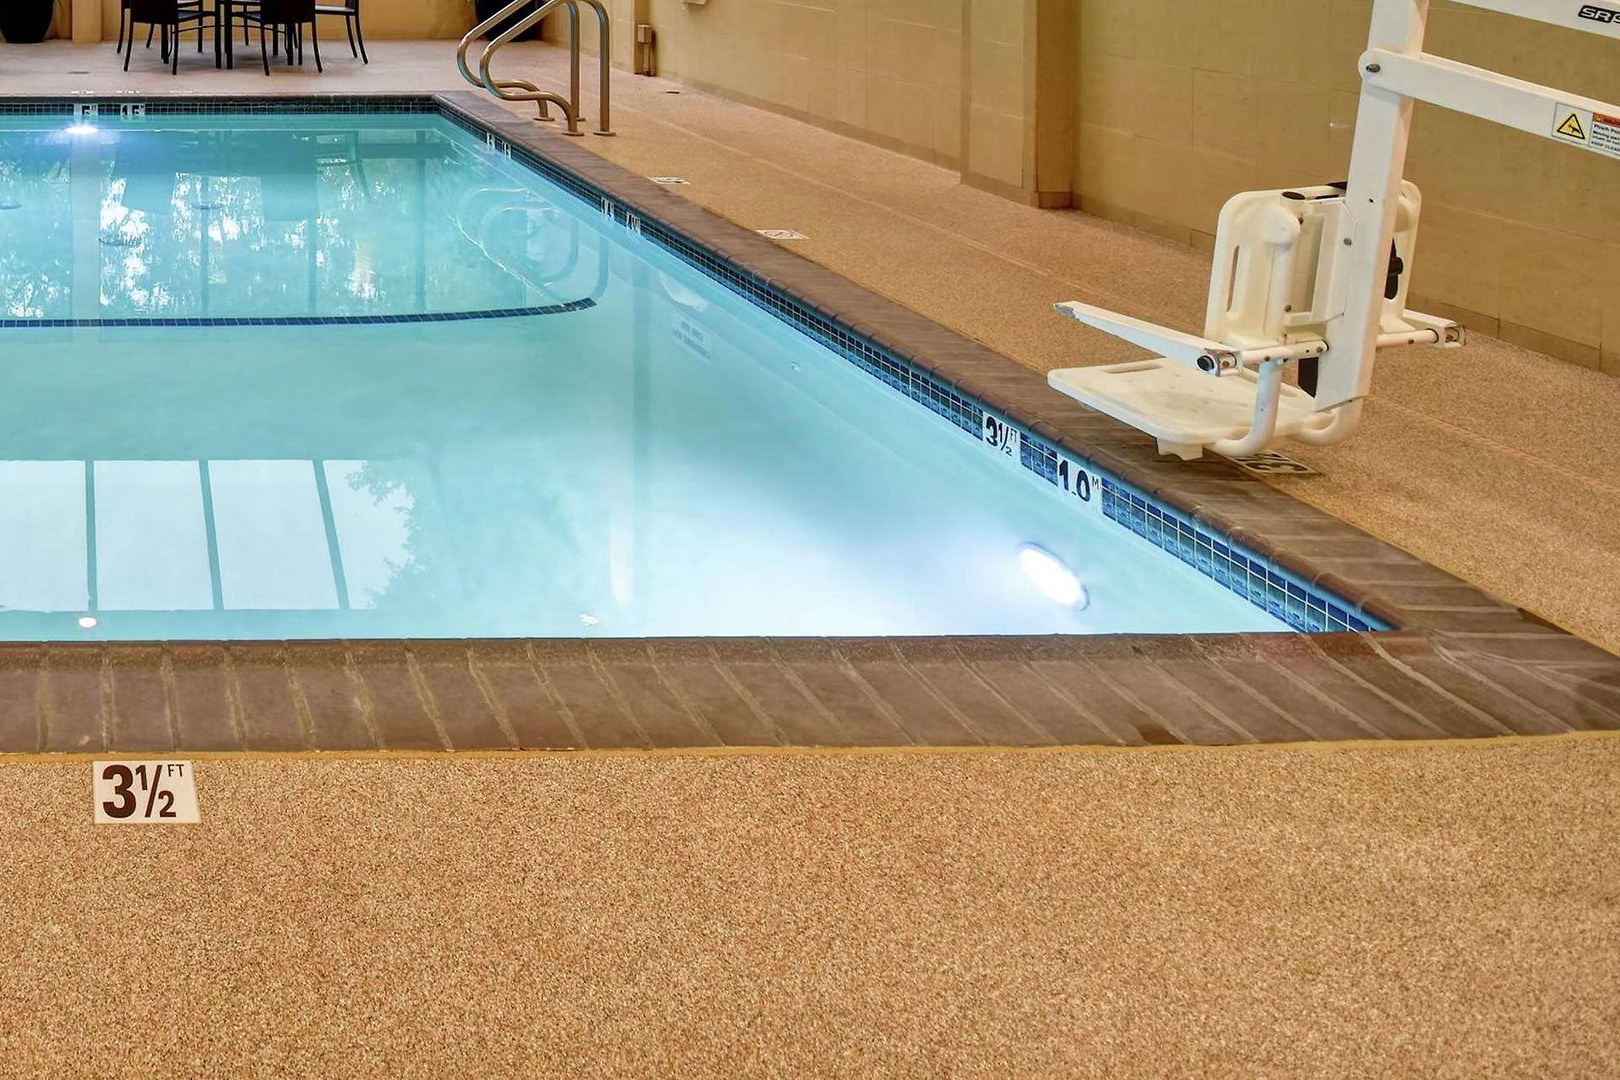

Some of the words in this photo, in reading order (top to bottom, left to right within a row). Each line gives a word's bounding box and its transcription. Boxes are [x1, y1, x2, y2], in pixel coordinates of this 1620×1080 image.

[1009, 428, 1018, 443] FT
[1058, 459, 1091, 503] 1.0
[1092, 476, 1100, 490] M
[168, 764, 184, 777] FT
